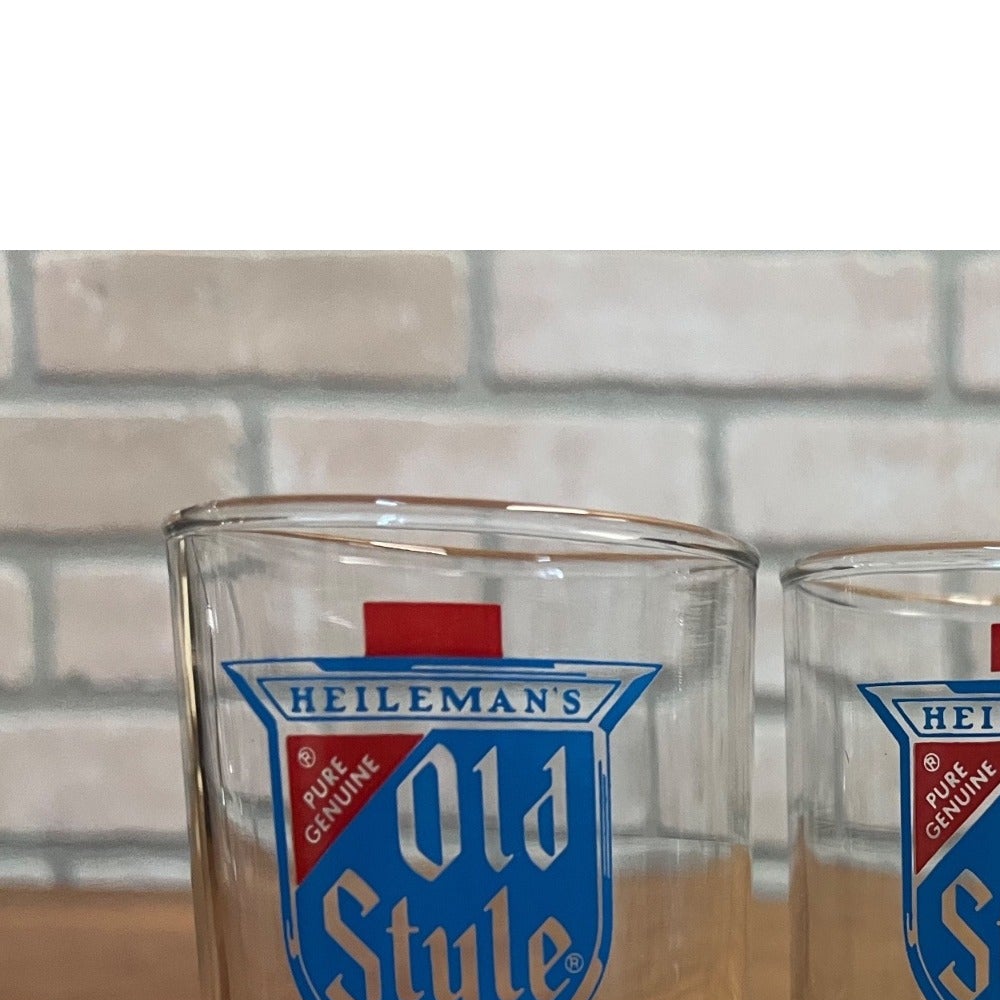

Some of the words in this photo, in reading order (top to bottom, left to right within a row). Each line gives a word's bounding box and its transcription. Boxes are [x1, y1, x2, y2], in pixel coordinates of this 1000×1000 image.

[291, 685, 583, 715] HEILEMAN'S
[303, 756, 348, 809] PURE
[304, 754, 380, 844] GENUINE
[398, 743, 569, 881] Old
[926, 761, 968, 809] PURE
[926, 759, 997, 840] GENUINE
